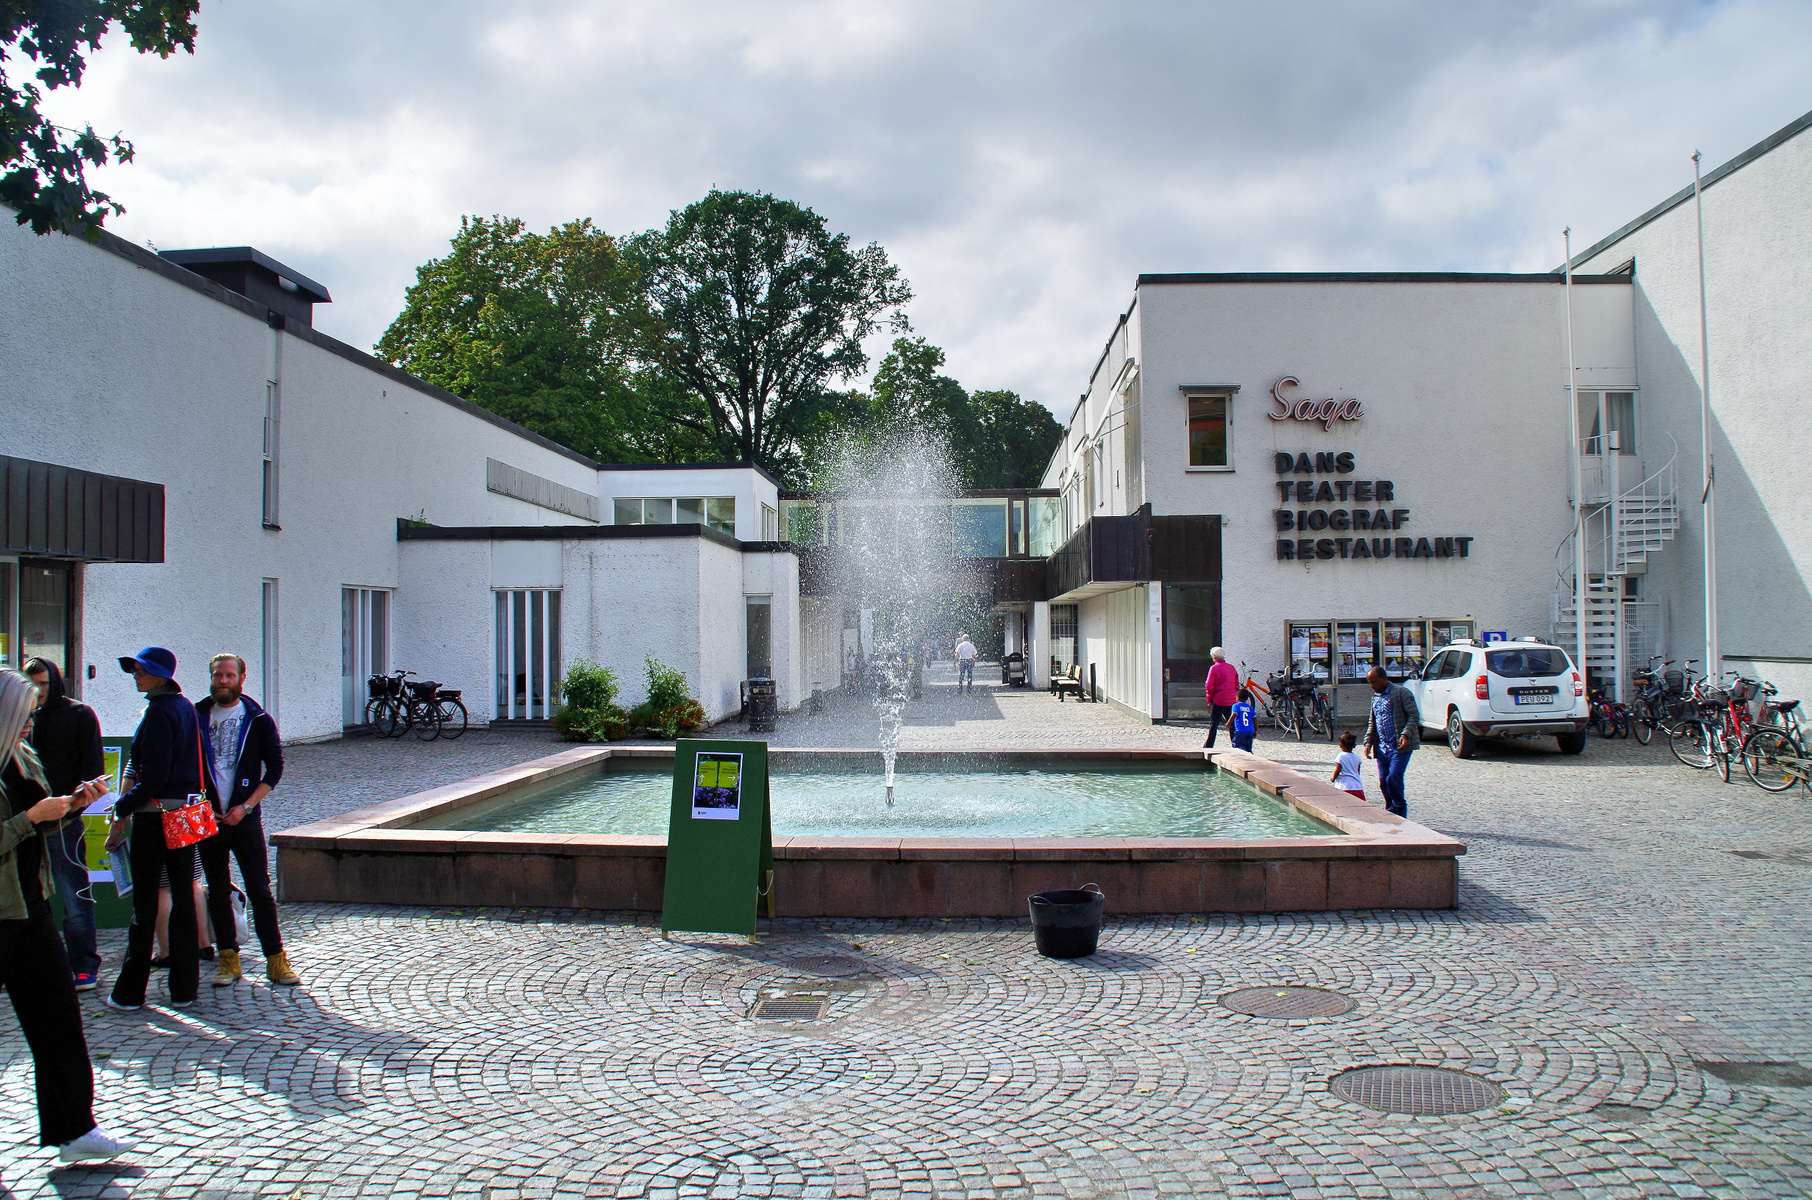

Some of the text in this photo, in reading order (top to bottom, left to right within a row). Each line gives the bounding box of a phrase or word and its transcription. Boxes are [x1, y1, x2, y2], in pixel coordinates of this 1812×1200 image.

[1267, 375, 1365, 432] Saga
[1275, 451, 1356, 474] DANS
[1276, 480, 1395, 503] TEATER
[1275, 508, 1410, 532] BIOGRAF
[1276, 536, 1474, 560] RESTAURANT
[1242, 712, 1249, 727] 6
